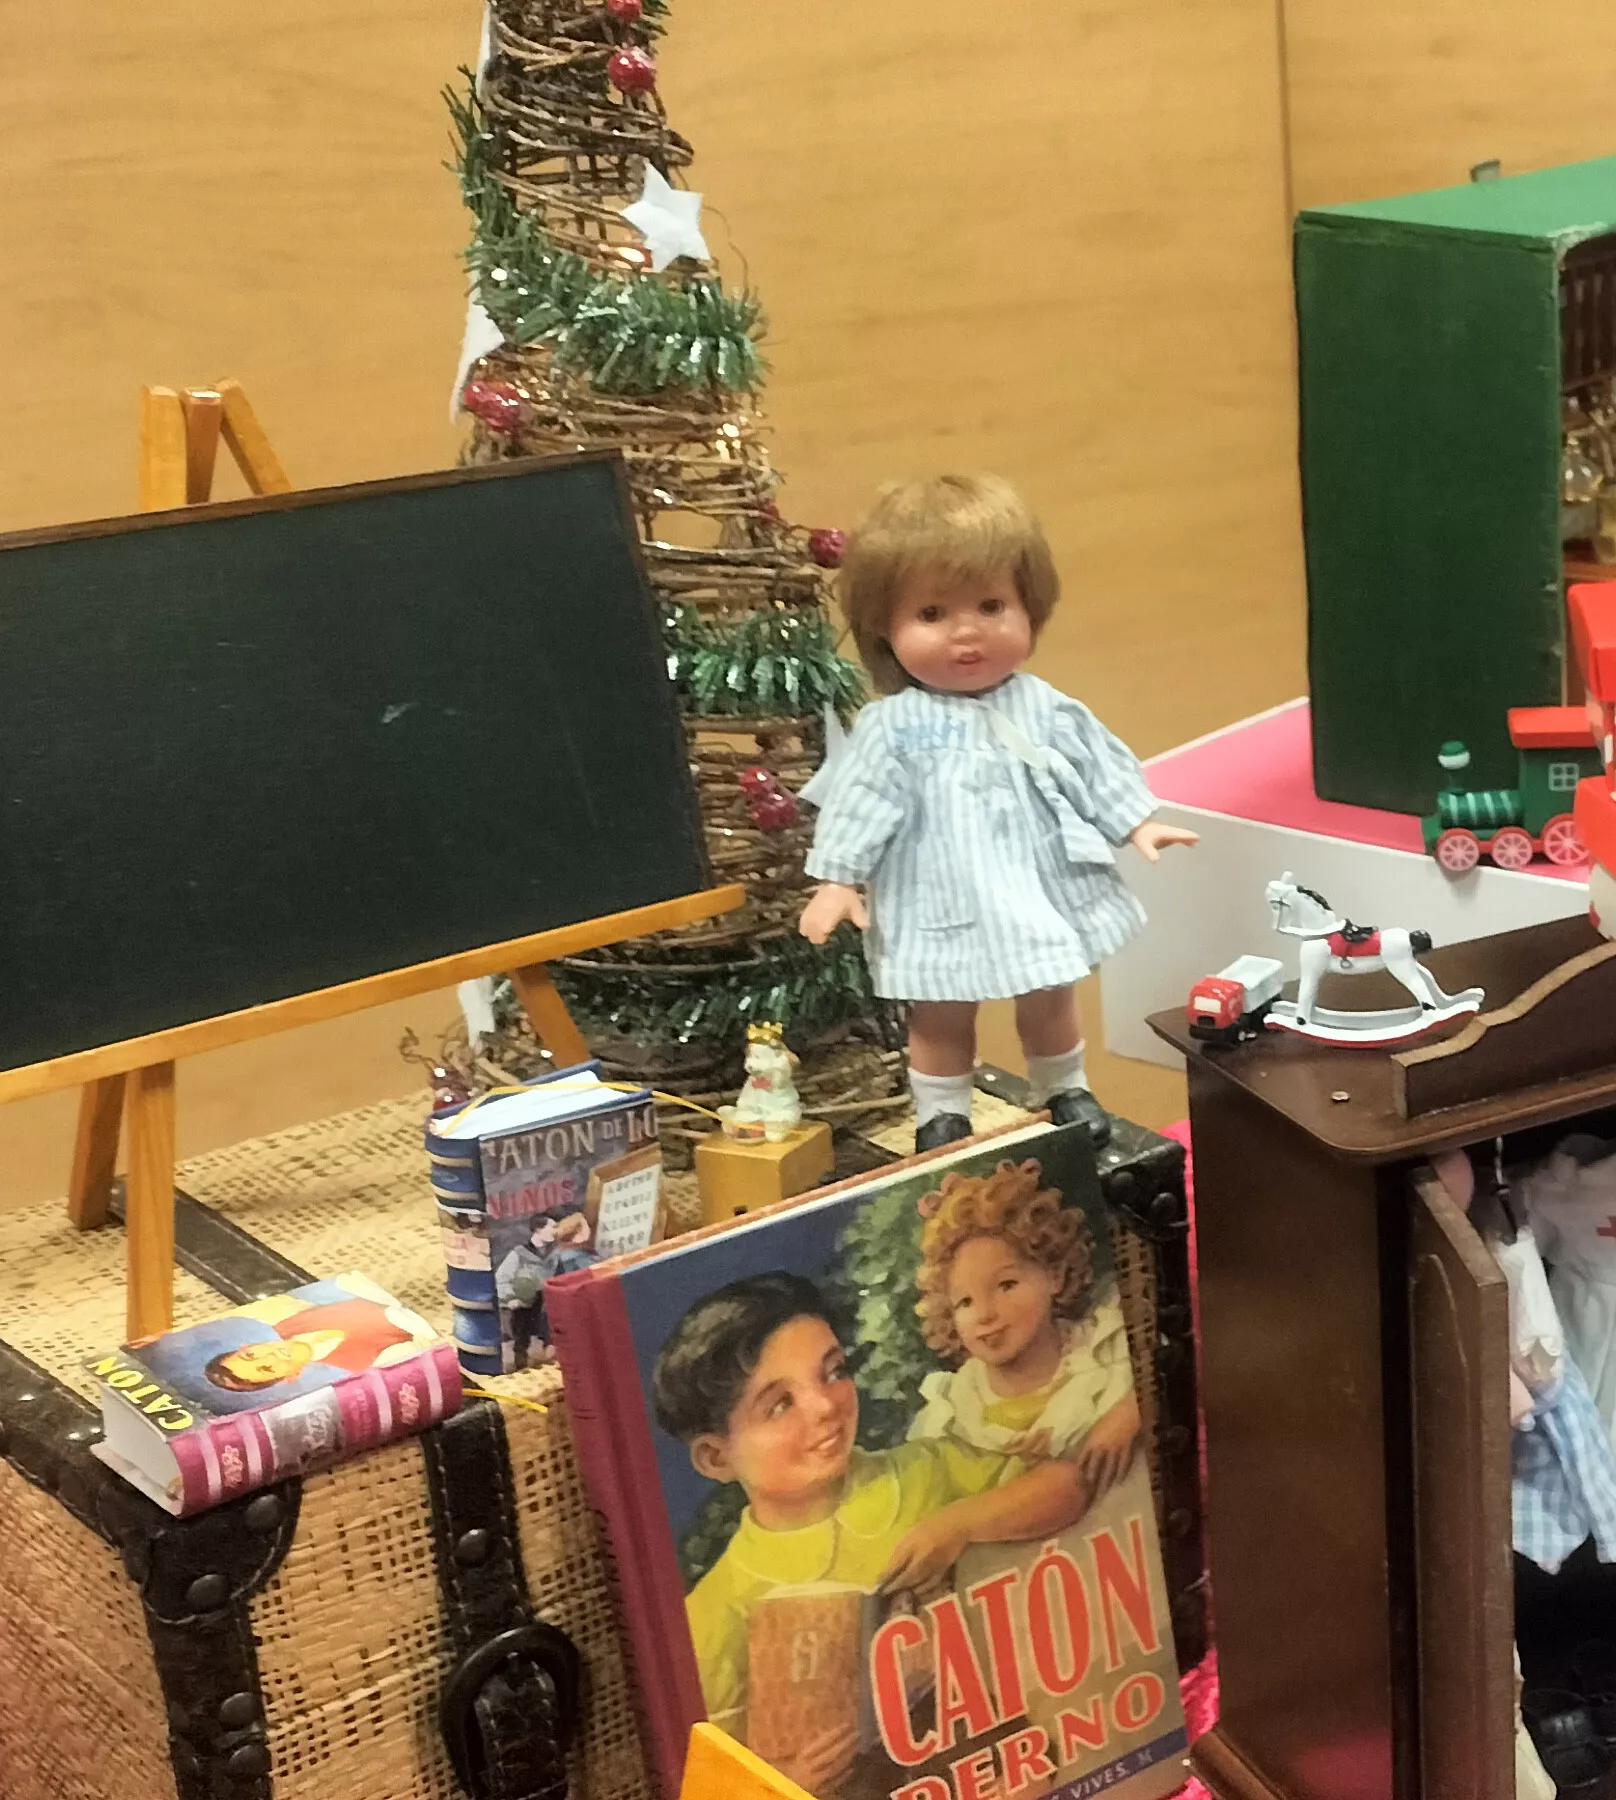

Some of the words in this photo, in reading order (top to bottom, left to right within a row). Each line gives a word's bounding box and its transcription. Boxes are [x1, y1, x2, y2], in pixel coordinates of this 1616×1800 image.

[601, 1117, 624, 1140] DE
[86, 1356, 194, 1430] CATON
[870, 1514, 1162, 1766] CATÓN
